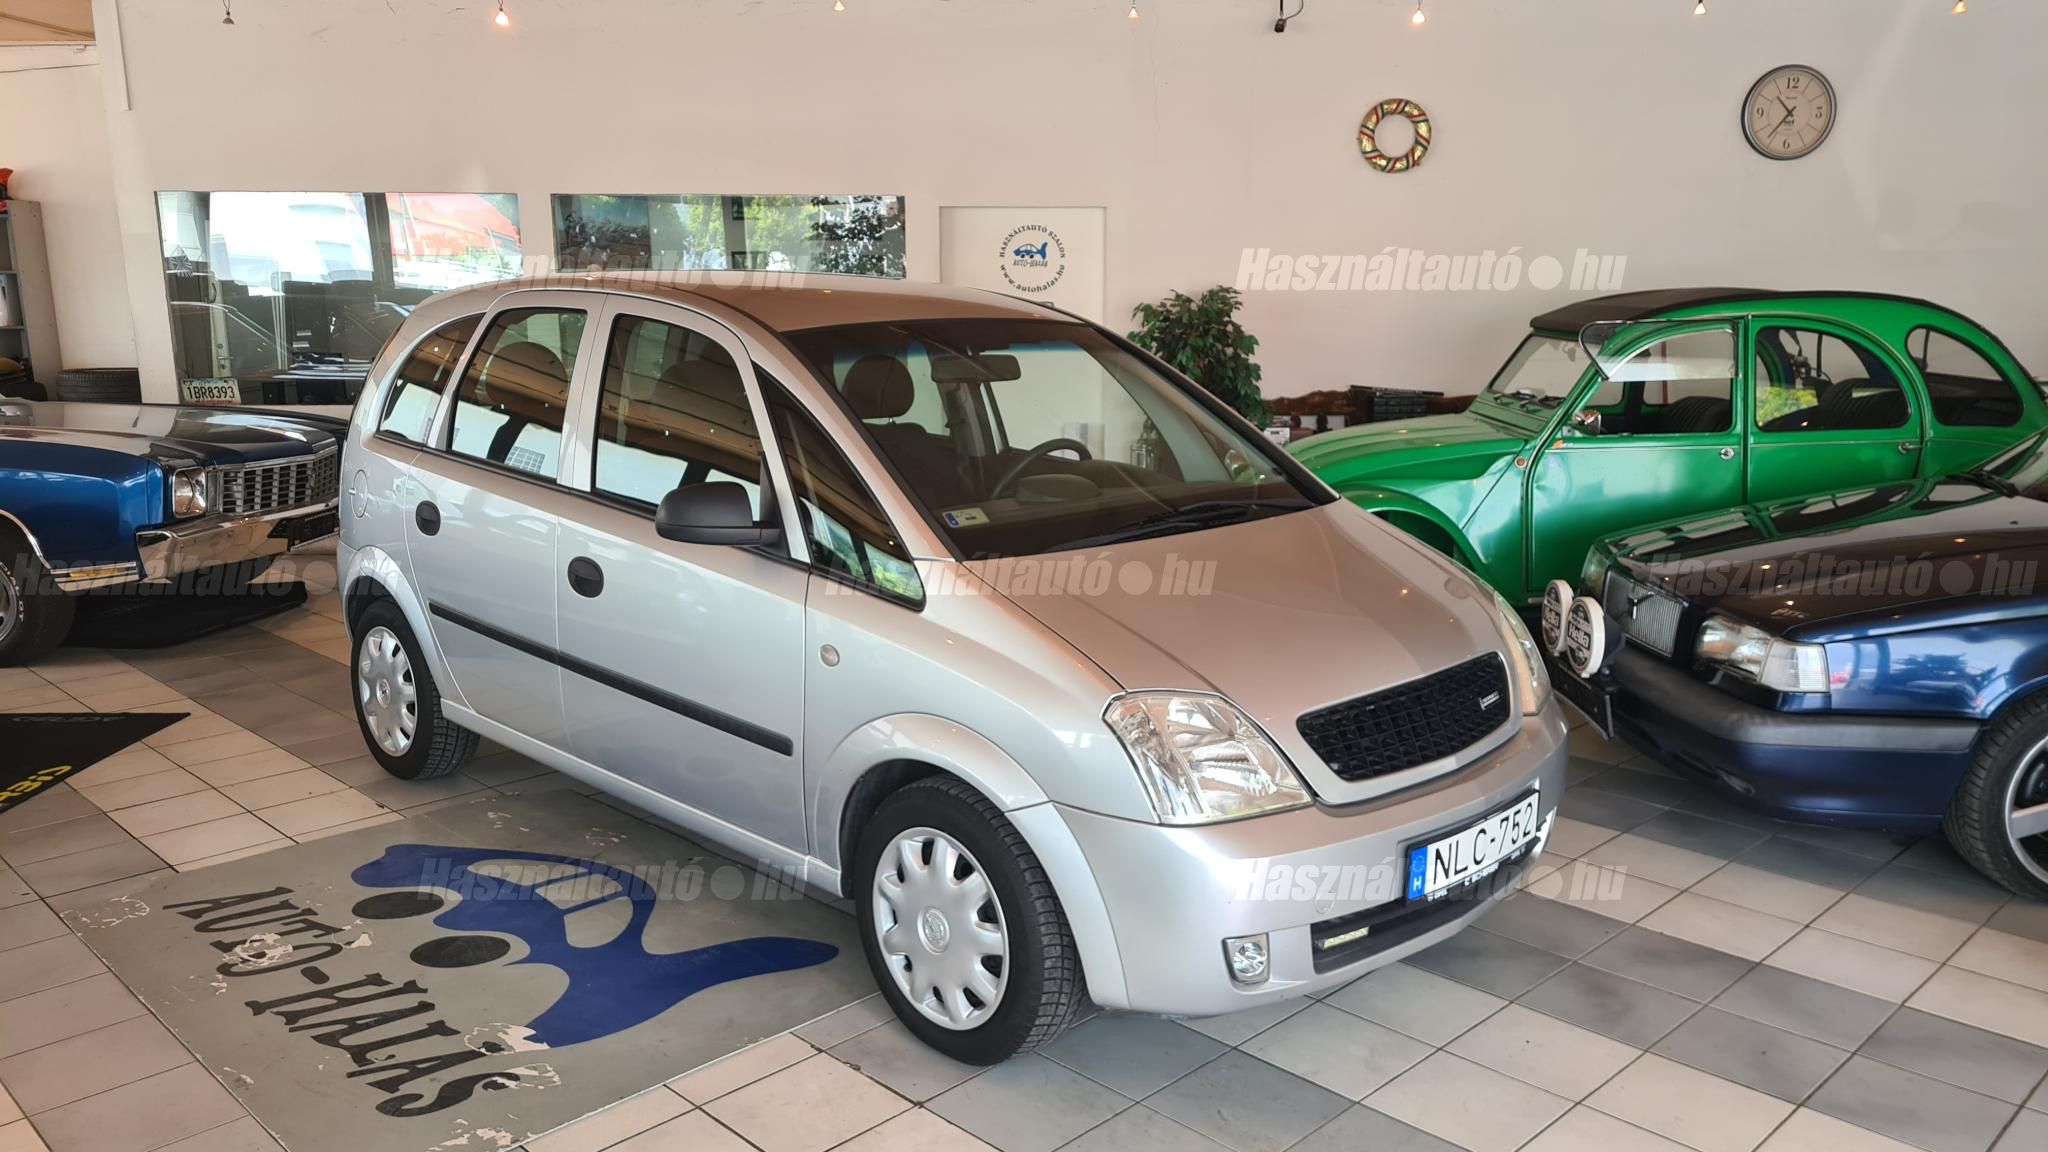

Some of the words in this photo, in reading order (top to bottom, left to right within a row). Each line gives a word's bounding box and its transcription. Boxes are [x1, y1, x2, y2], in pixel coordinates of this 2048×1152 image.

[1786, 77, 1799, 89] 12
[1000, 264, 1065, 293] www.autohalas.hu
[187, 386, 235, 399] 1BR8393
[1568, 623, 1590, 648] Hella
[1433, 802, 1533, 885] NLC-752
[1413, 876, 1422, 892] H
